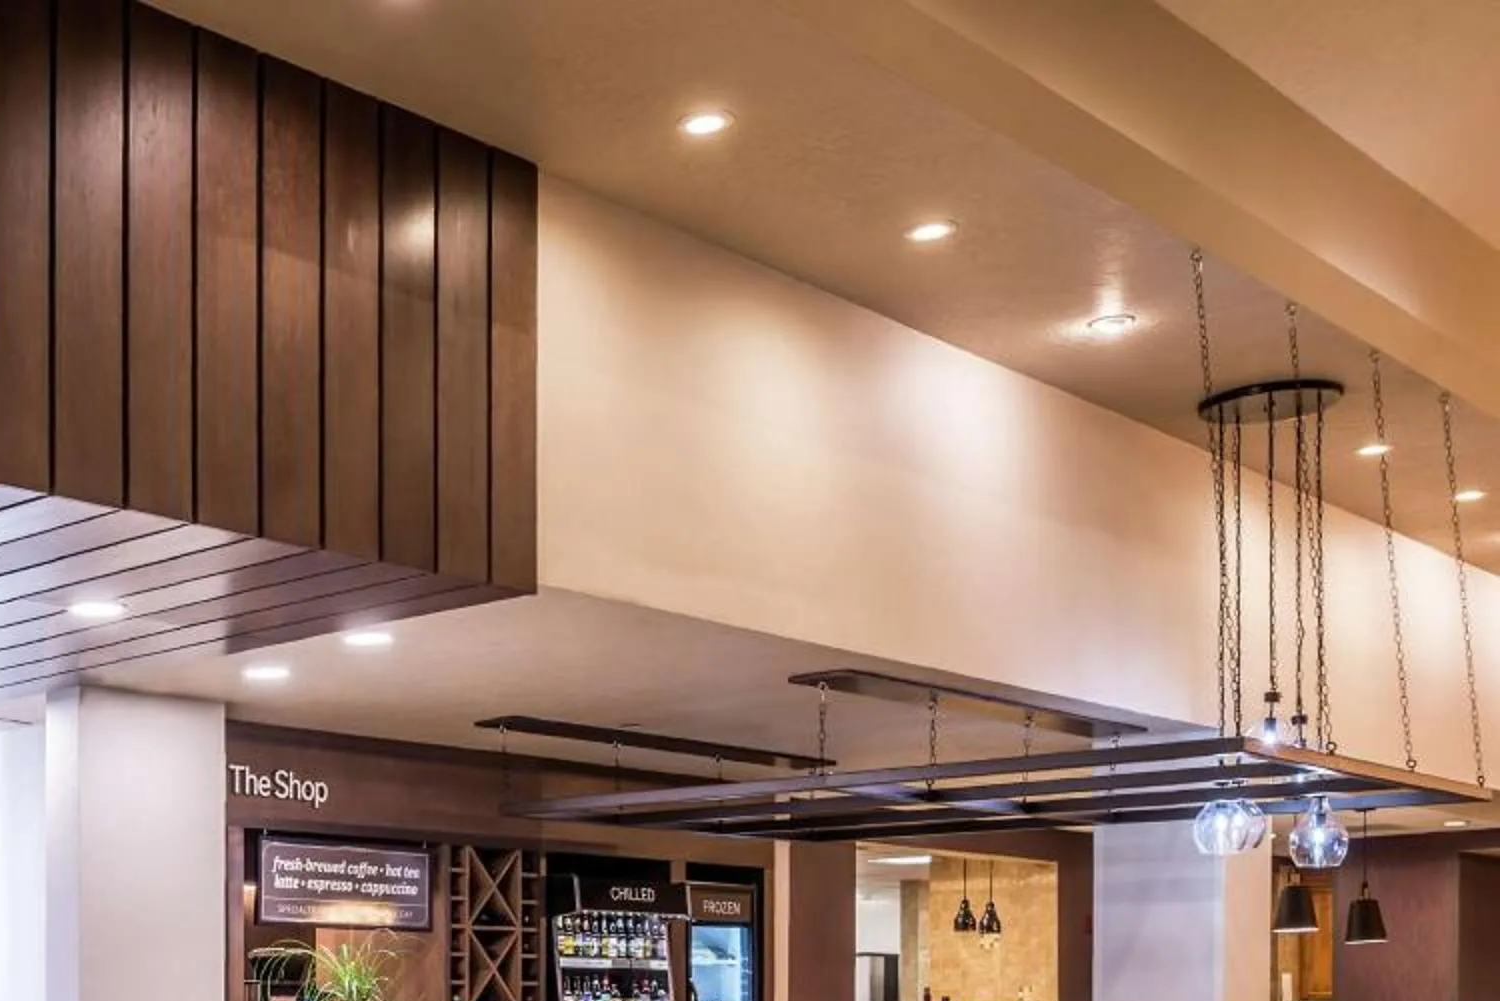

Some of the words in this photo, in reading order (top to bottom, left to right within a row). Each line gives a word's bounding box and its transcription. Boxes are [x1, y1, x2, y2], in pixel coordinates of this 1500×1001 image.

[229, 763, 271, 797] The
[274, 769, 329, 808] Shop
[272, 856, 346, 874] fresh-brewed
[347, 861, 379, 878] coffee
[385, 863, 402, 878] hot
[403, 867, 421, 879] tea
[273, 874, 300, 889] latte
[306, 878, 352, 894] espresso
[360, 881, 419, 897] cappuccino
[609, 886, 656, 902] CHILLED
[703, 900, 741, 915] FROZEN
